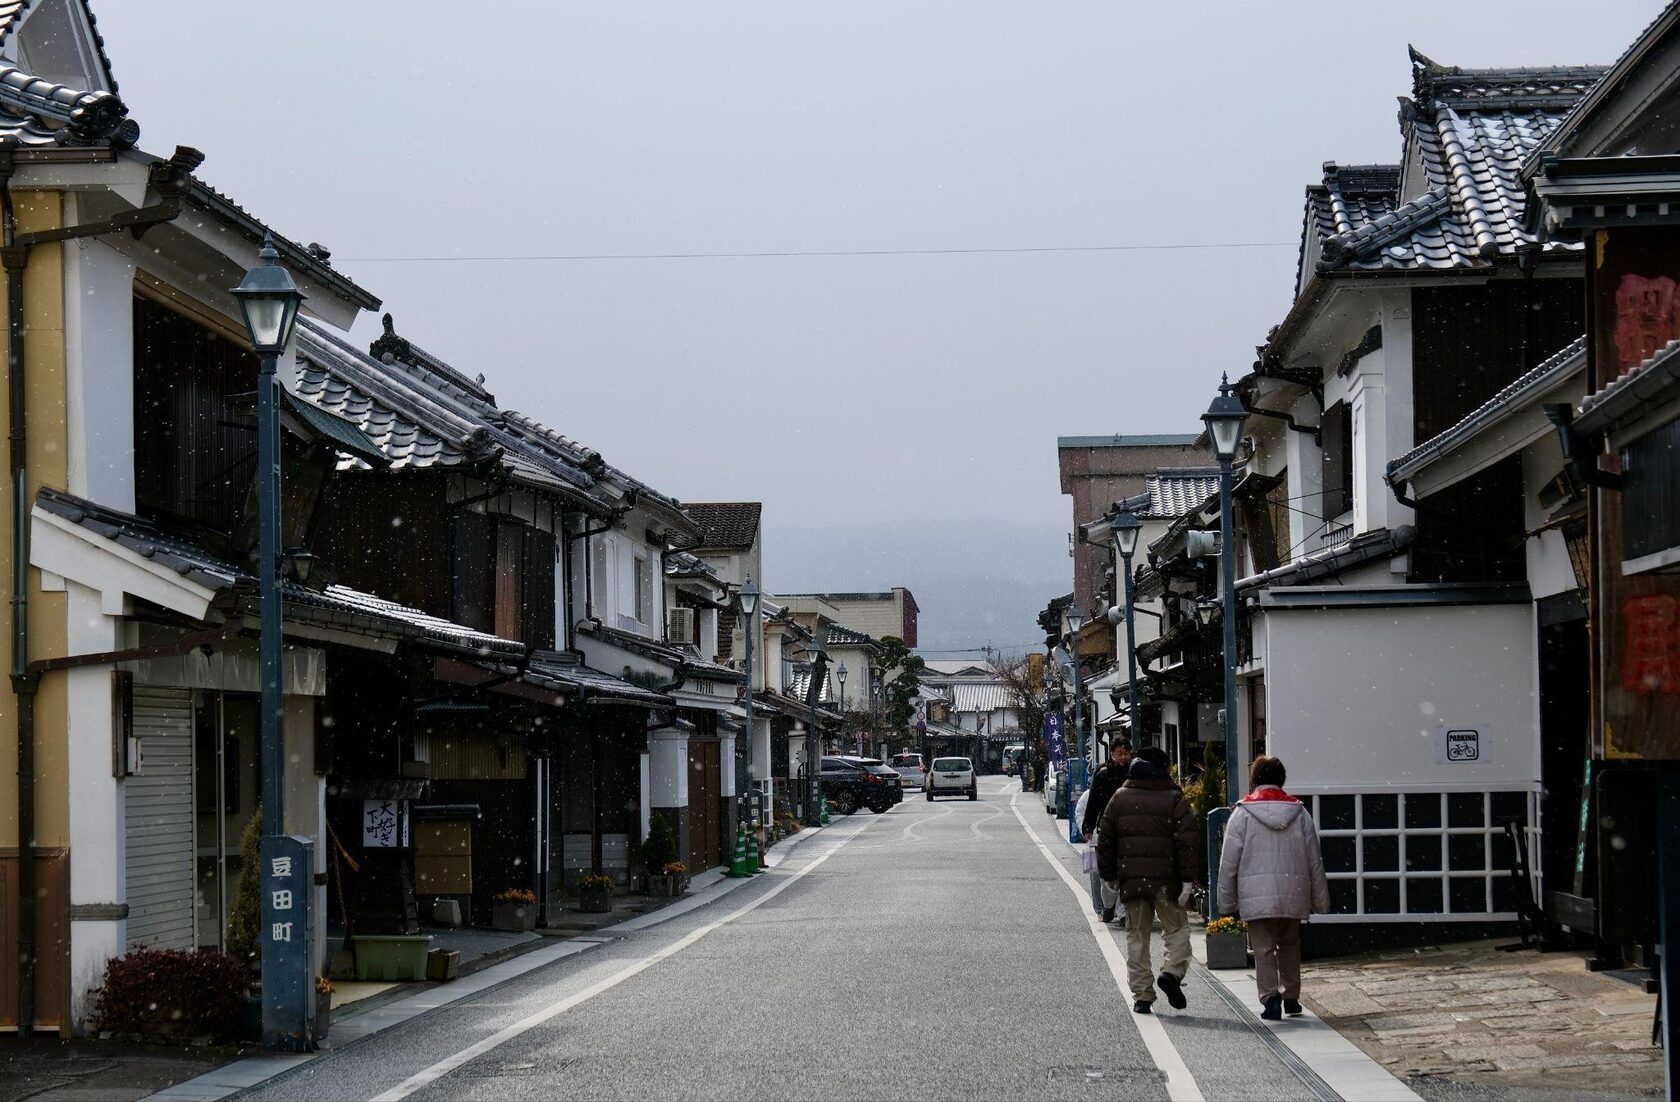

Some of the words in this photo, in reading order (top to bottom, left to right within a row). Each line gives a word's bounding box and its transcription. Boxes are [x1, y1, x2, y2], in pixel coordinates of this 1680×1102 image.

[1449, 734, 1476, 742] PARKING
[366, 809, 380, 839] 下町
[379, 801, 396, 847] 大好き
[271, 856, 293, 942] 豆田町
